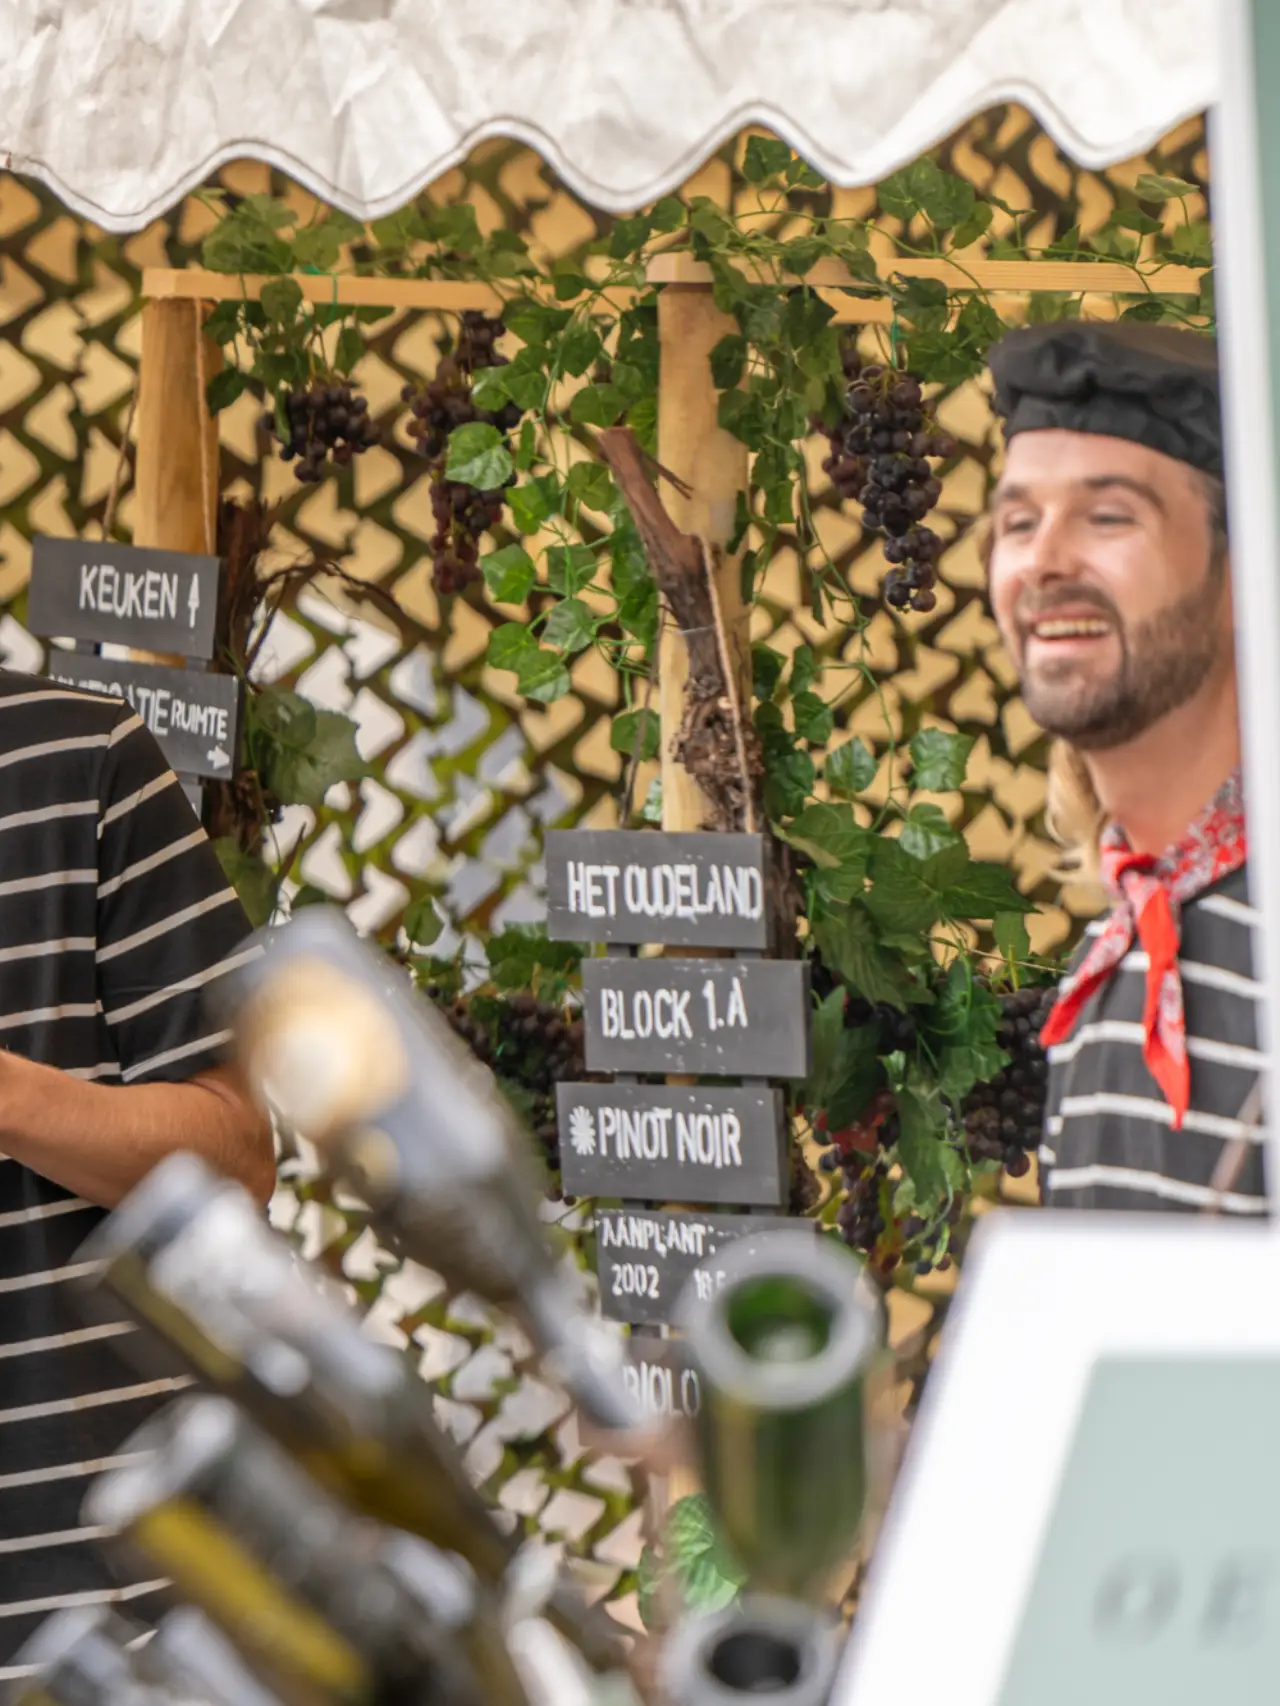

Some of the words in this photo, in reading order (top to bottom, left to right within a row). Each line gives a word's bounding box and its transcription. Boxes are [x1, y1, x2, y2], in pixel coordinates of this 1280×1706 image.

[79, 564, 178, 620] KEUKEN
[171, 699, 228, 740] RUIMTE
[567, 860, 619, 918] HET
[624, 863, 764, 920] OUDELAND
[600, 988, 694, 1039] BLOCK
[702, 976, 748, 1031] 1.A
[597, 1106, 672, 1161] PINOT
[676, 1111, 742, 1168] NOIR
[611, 1262, 660, 1299] 2002
